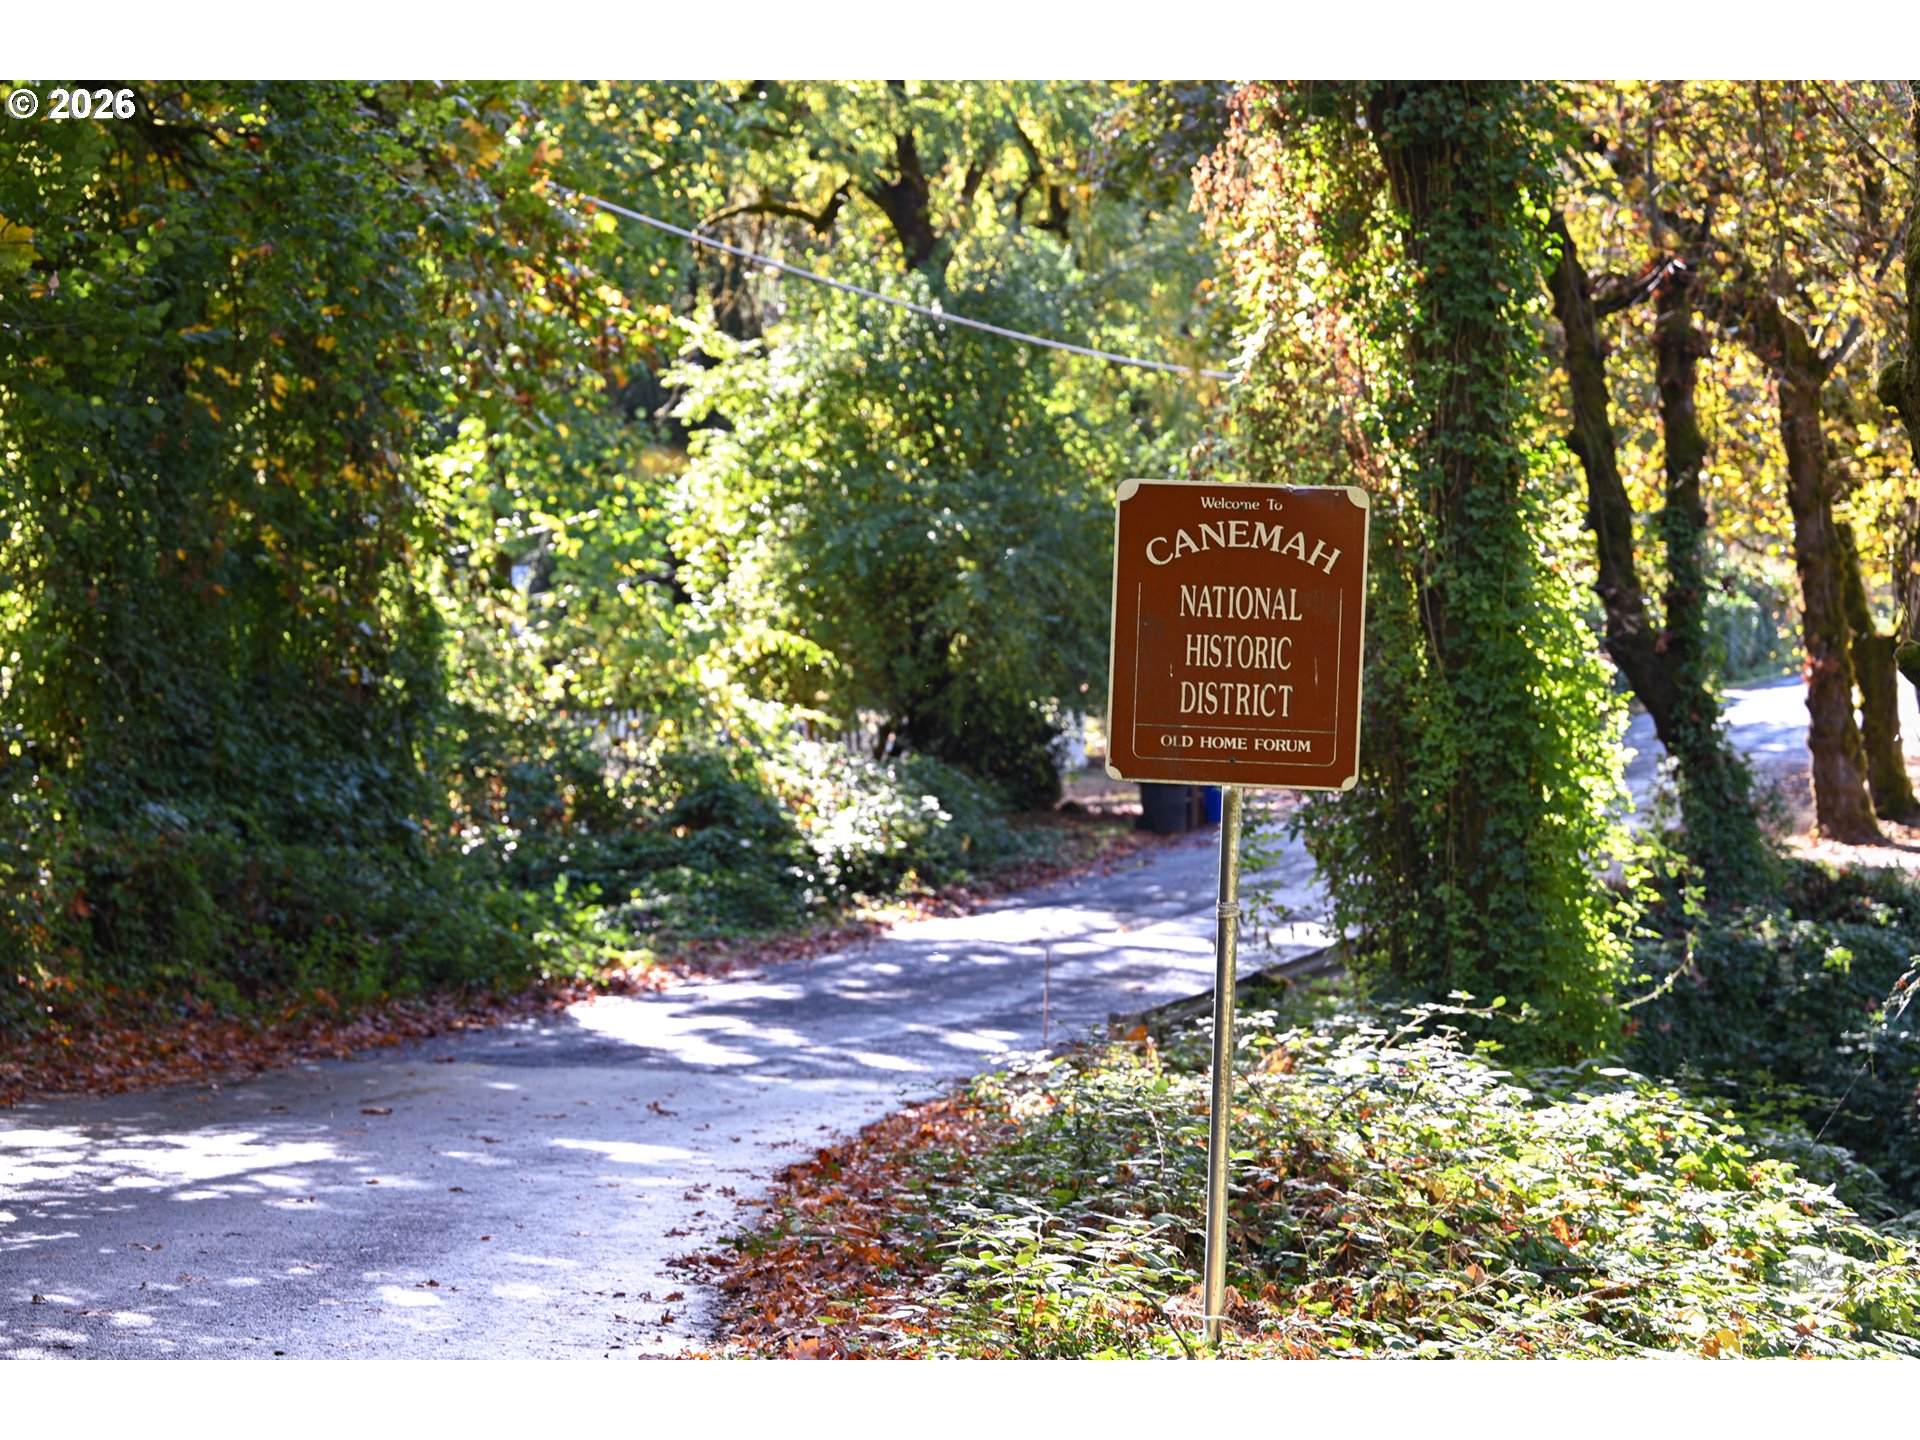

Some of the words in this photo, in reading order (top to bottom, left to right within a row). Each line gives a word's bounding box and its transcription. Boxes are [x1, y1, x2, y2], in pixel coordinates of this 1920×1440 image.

[1200, 496, 1260, 511] Welcome
[1266, 498, 1283, 511] To
[1145, 520, 1342, 575] CANEMAH
[1179, 584, 1303, 621] NATIONAL
[1185, 633, 1292, 671] HISTORIC
[1179, 681, 1293, 718] DISTRICT
[1160, 734, 1194, 748] OLD
[1200, 736, 1248, 750] HOME
[1254, 738, 1312, 753] FORUM
